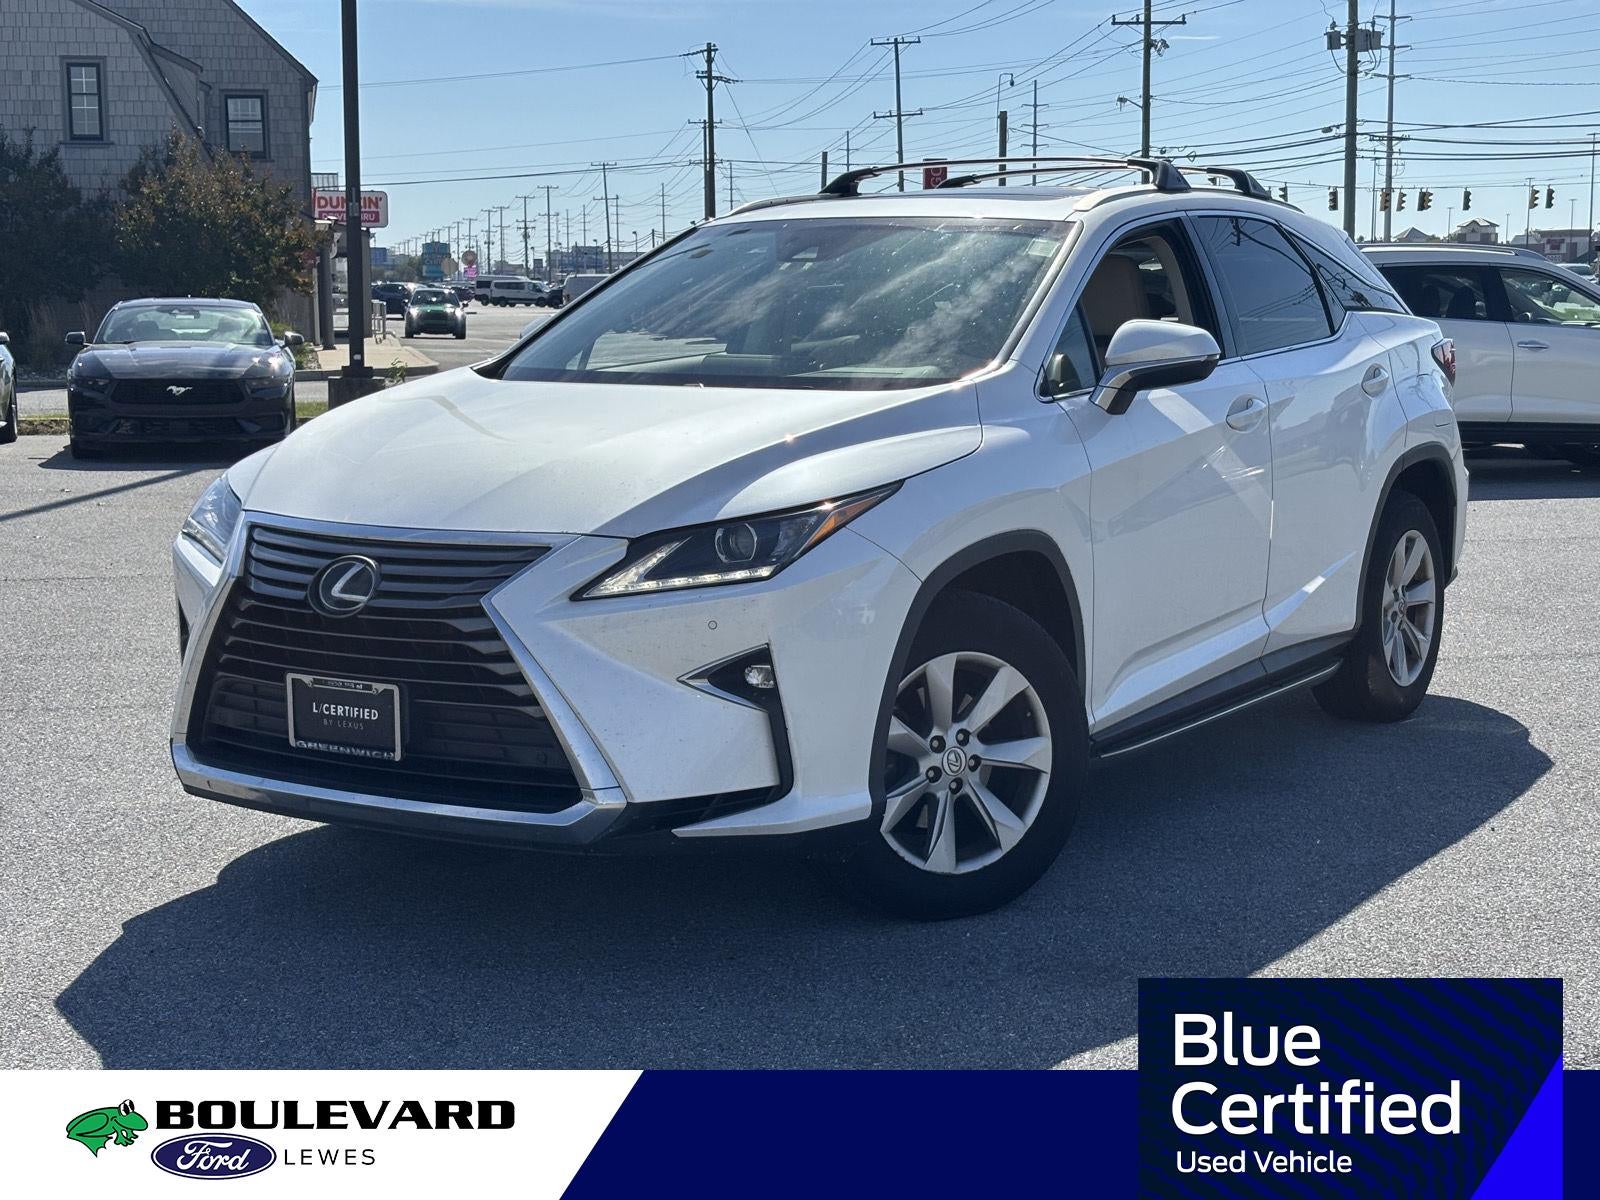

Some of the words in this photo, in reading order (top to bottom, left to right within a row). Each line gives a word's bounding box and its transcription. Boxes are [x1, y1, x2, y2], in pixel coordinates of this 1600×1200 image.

[316, 196, 382, 209] DUIN'
[312, 702, 379, 720] L/CERTIFIED
[323, 718, 333, 726] BY
[337, 719, 364, 730] LEXUS
